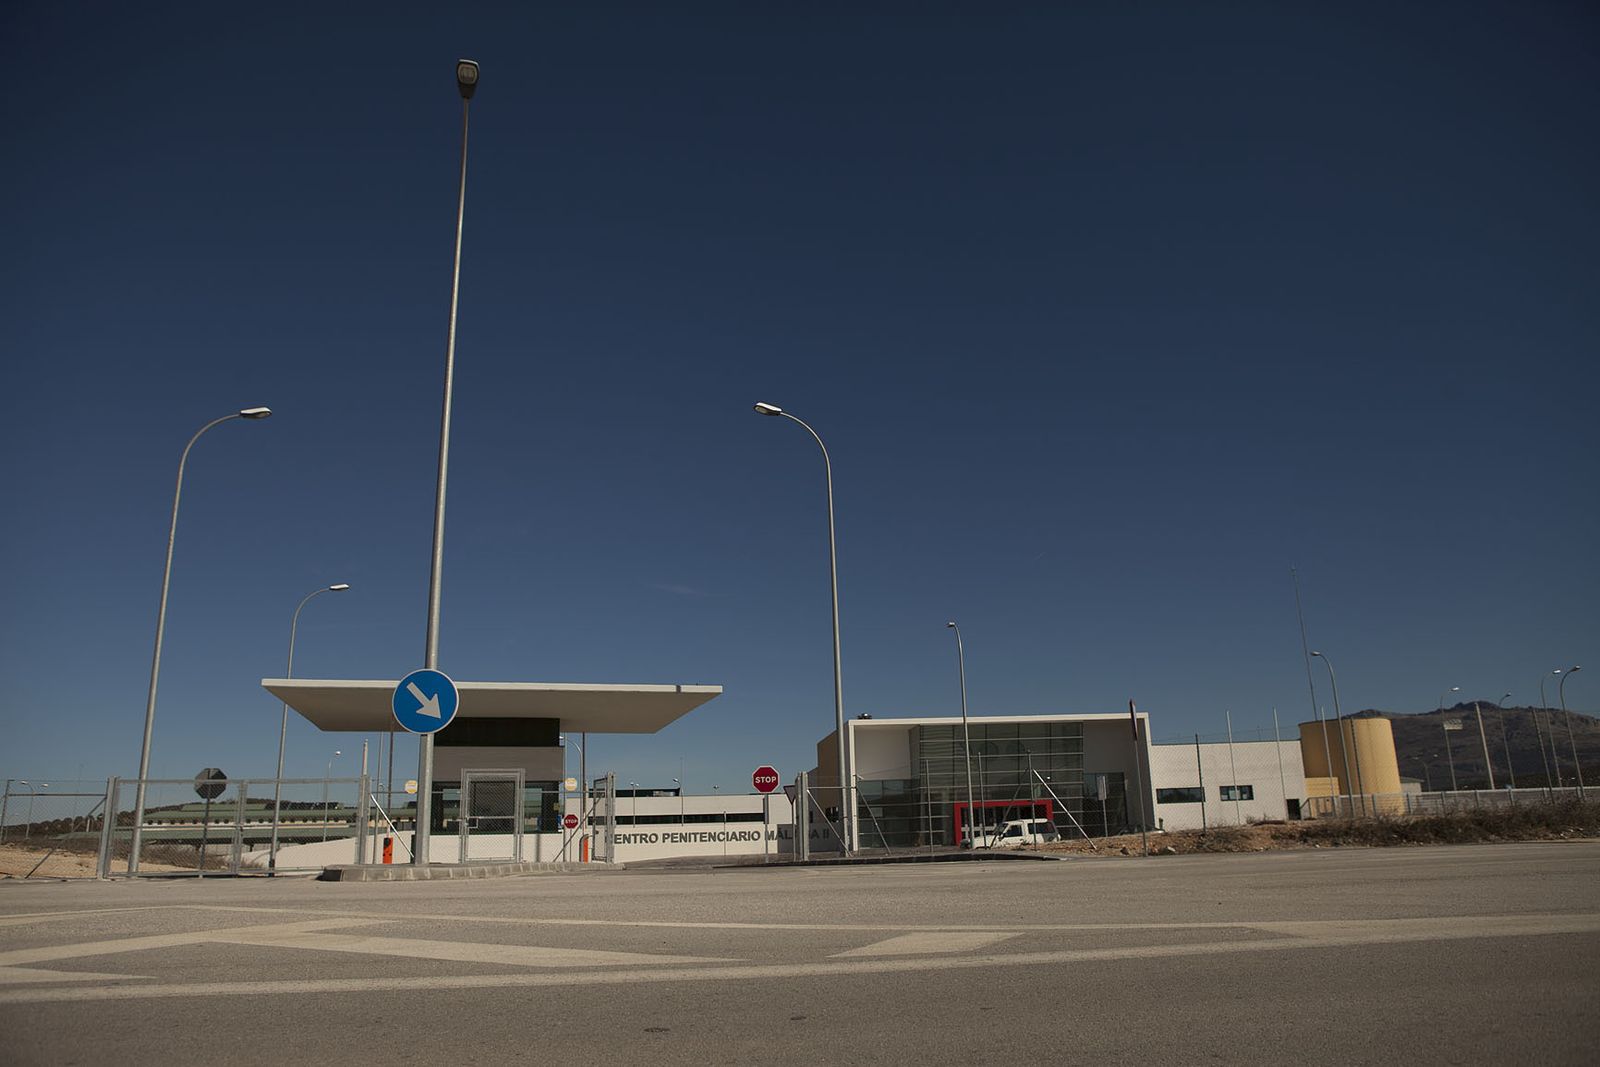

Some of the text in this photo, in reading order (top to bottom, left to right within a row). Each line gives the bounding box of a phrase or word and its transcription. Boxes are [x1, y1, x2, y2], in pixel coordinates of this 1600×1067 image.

[755, 776, 777, 784] STOP
[606, 833, 659, 845] ENTRO
[662, 830, 761, 844] PENITENCIARIO
